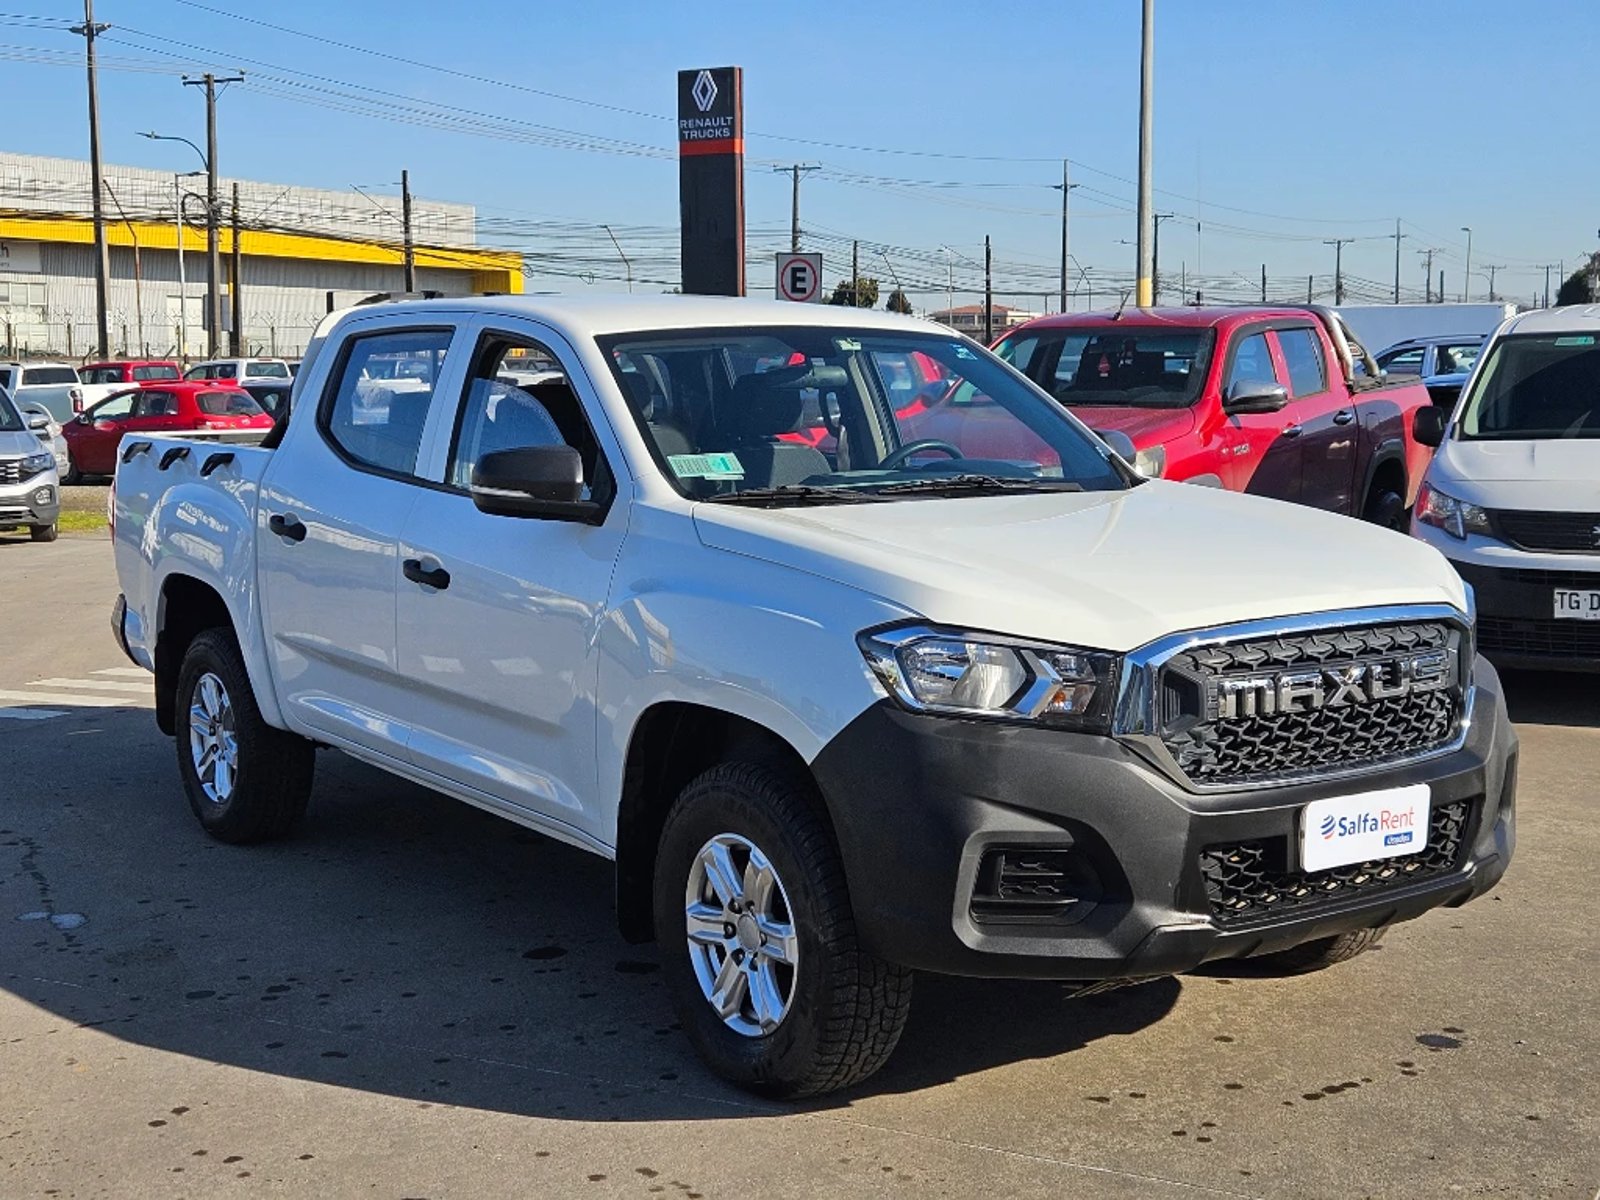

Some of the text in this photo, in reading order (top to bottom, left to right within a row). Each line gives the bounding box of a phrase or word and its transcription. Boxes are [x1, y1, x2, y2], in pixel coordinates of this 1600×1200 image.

[680, 116, 733, 128] RENAULT
[683, 128, 730, 139] TRUCKS
[791, 267, 806, 294] E
[1218, 653, 1448, 718] MAXUS
[1338, 806, 1415, 837] SalfaRent
